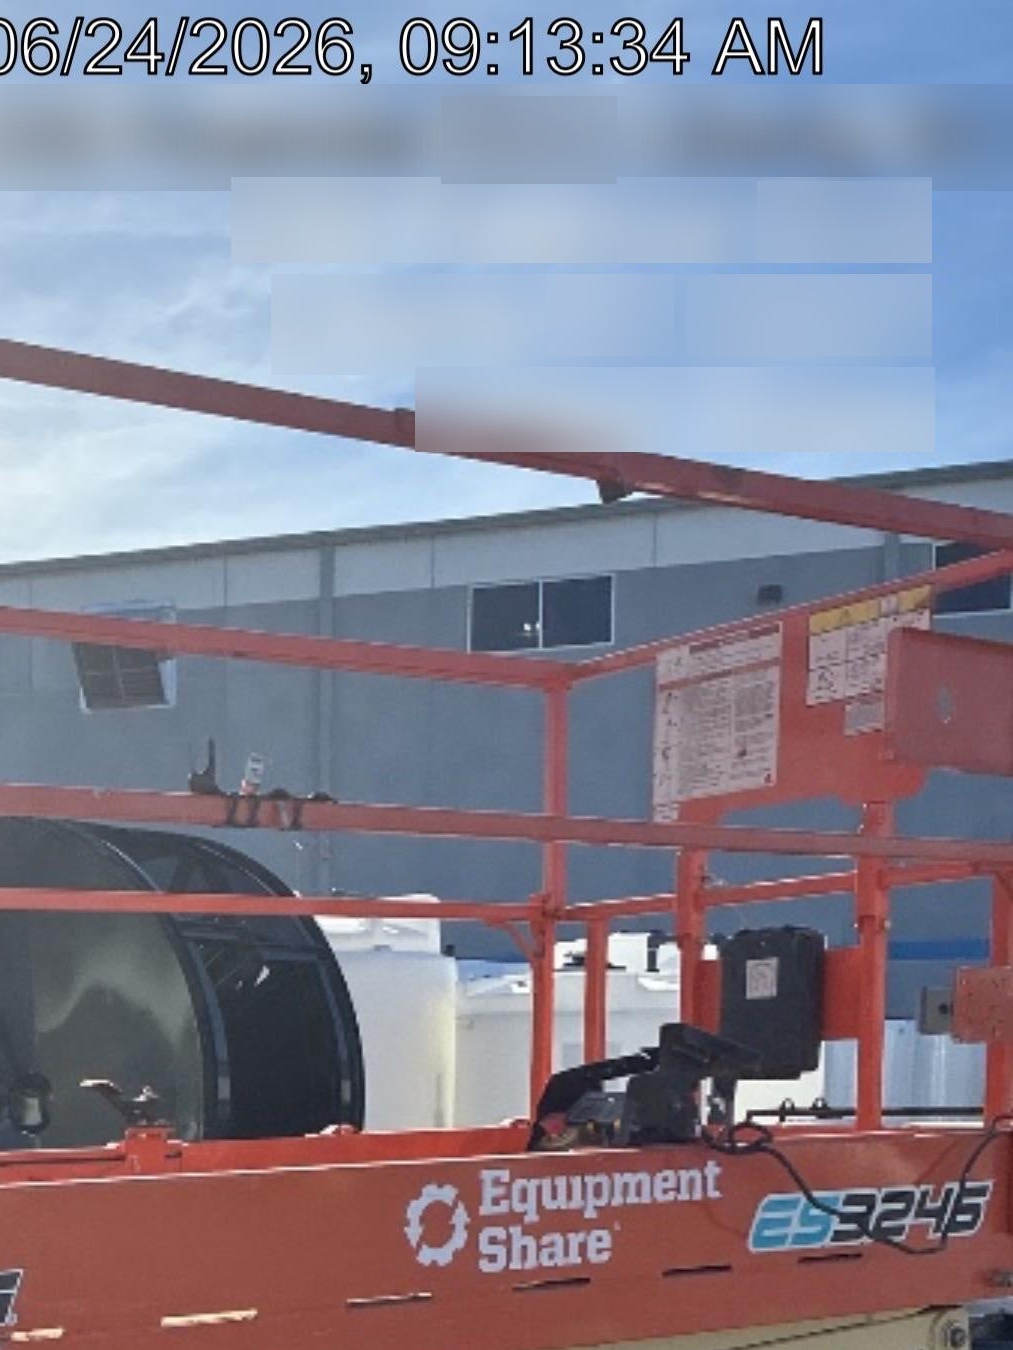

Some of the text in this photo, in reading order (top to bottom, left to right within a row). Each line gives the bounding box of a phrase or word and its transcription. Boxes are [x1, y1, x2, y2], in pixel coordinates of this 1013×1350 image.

[478, 1160, 723, 1223] Equipment
[748, 1179, 995, 1254] ES3246
[478, 1225, 613, 1273] Share
